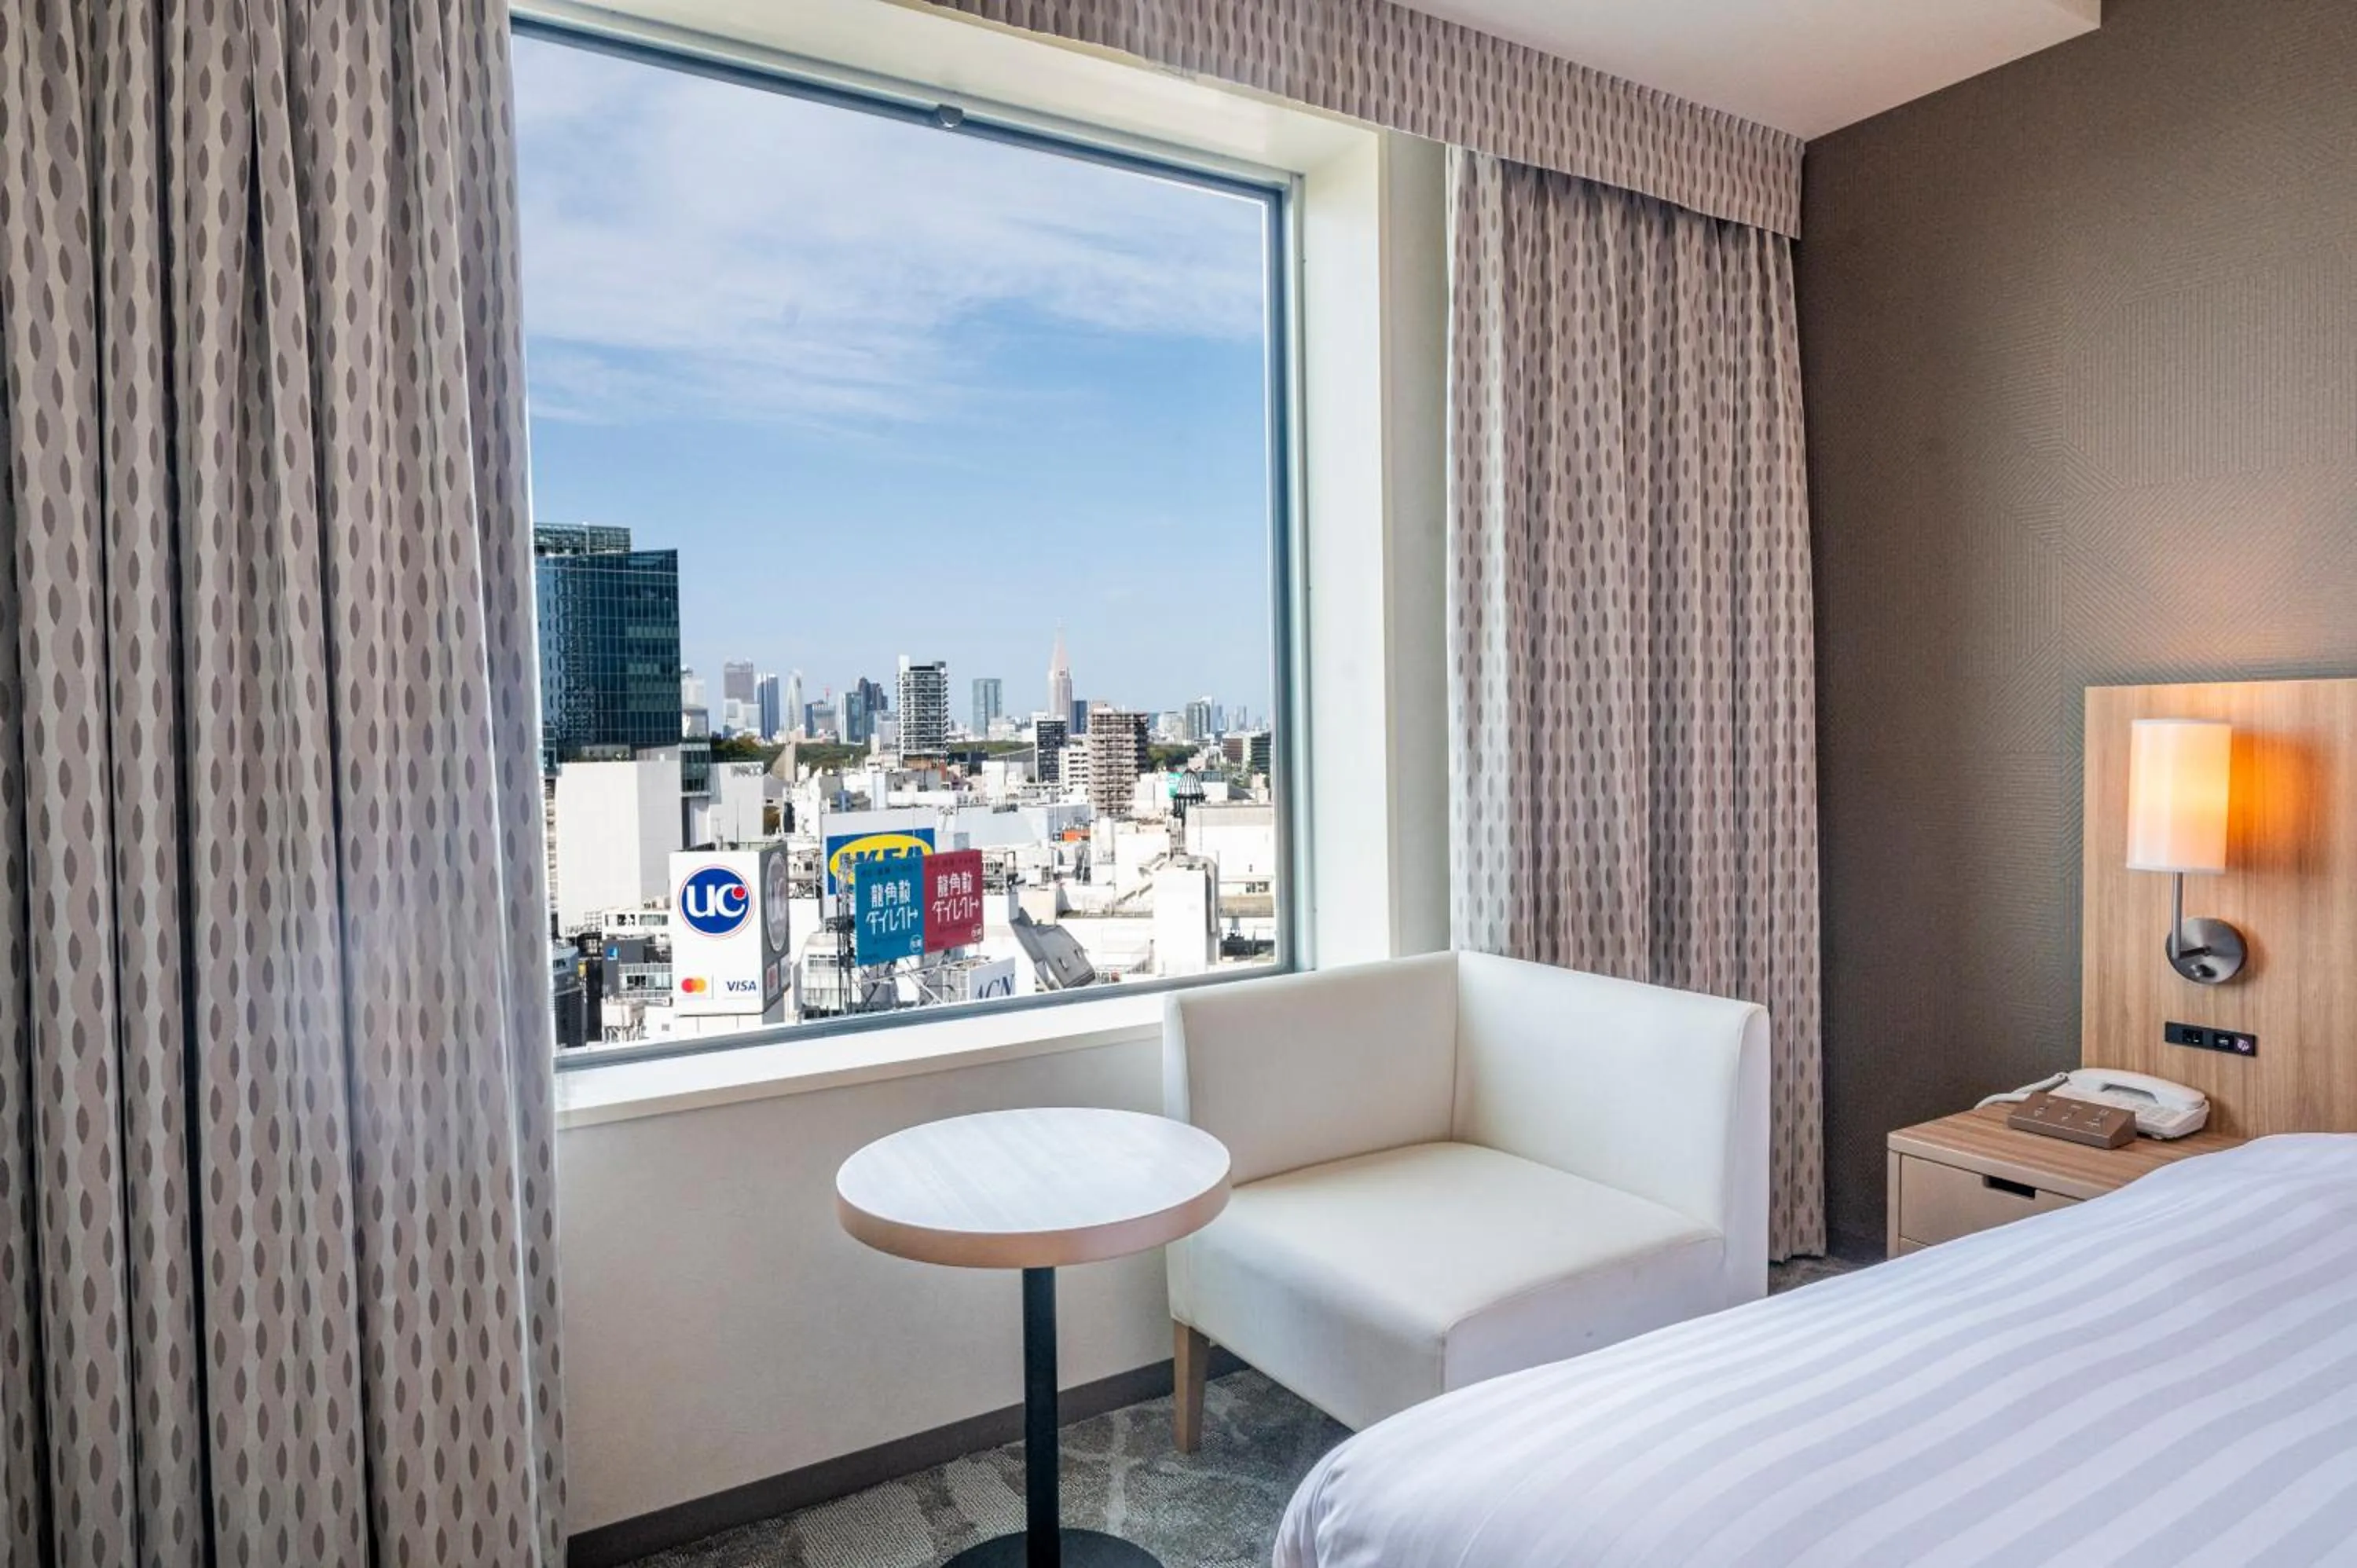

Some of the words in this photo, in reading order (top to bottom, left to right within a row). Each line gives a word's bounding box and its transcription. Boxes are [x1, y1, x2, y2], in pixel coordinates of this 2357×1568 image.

[870, 879, 911, 909] 龍角散
[937, 870, 974, 898] 龍角散
[687, 883, 746, 918] UC
[726, 980, 757, 992] VISA
